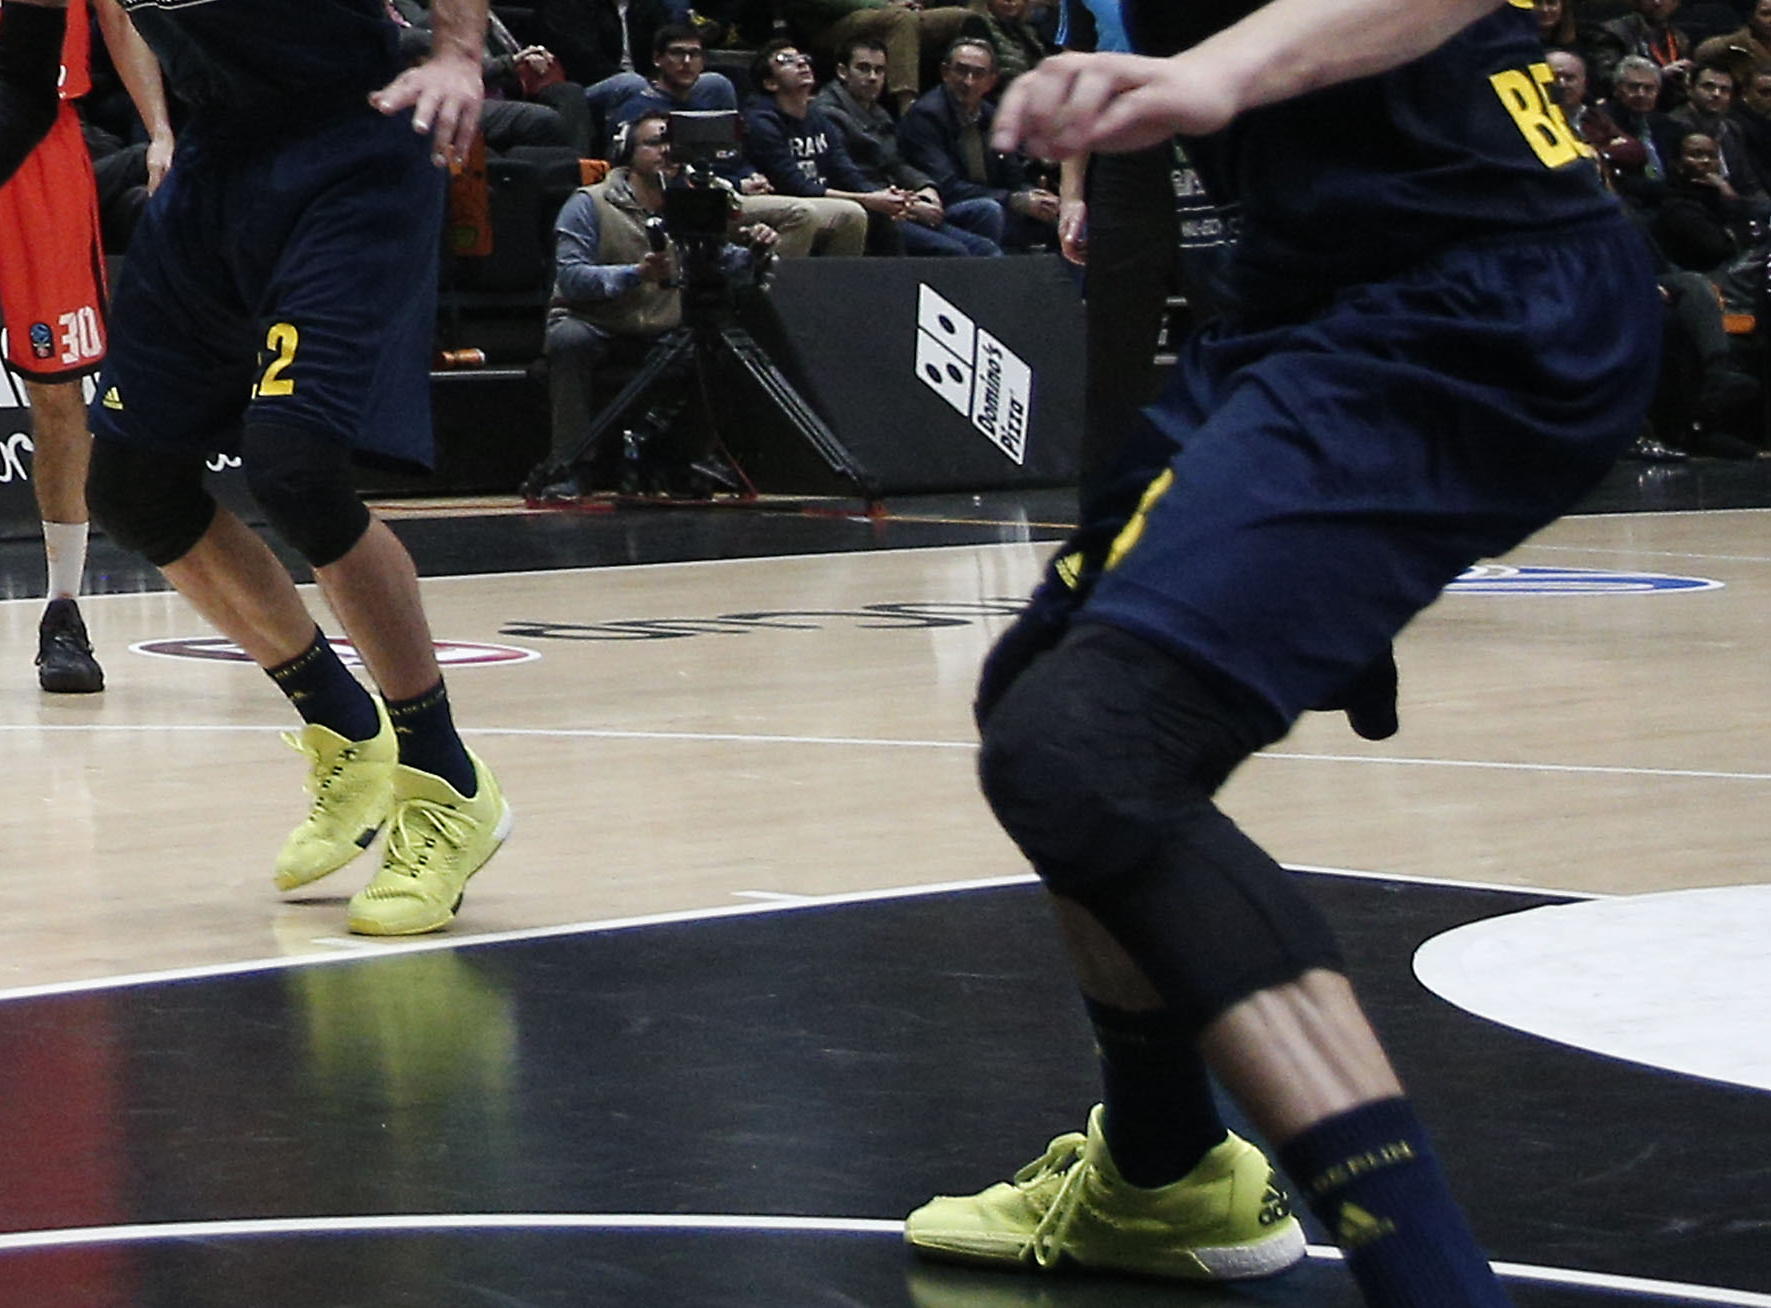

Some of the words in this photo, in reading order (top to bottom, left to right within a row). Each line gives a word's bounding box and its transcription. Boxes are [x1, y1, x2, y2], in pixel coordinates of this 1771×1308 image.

[60, 304, 105, 365] 30
[977, 341, 1004, 436] Domino's
[1000, 399, 1024, 459] Pizza
